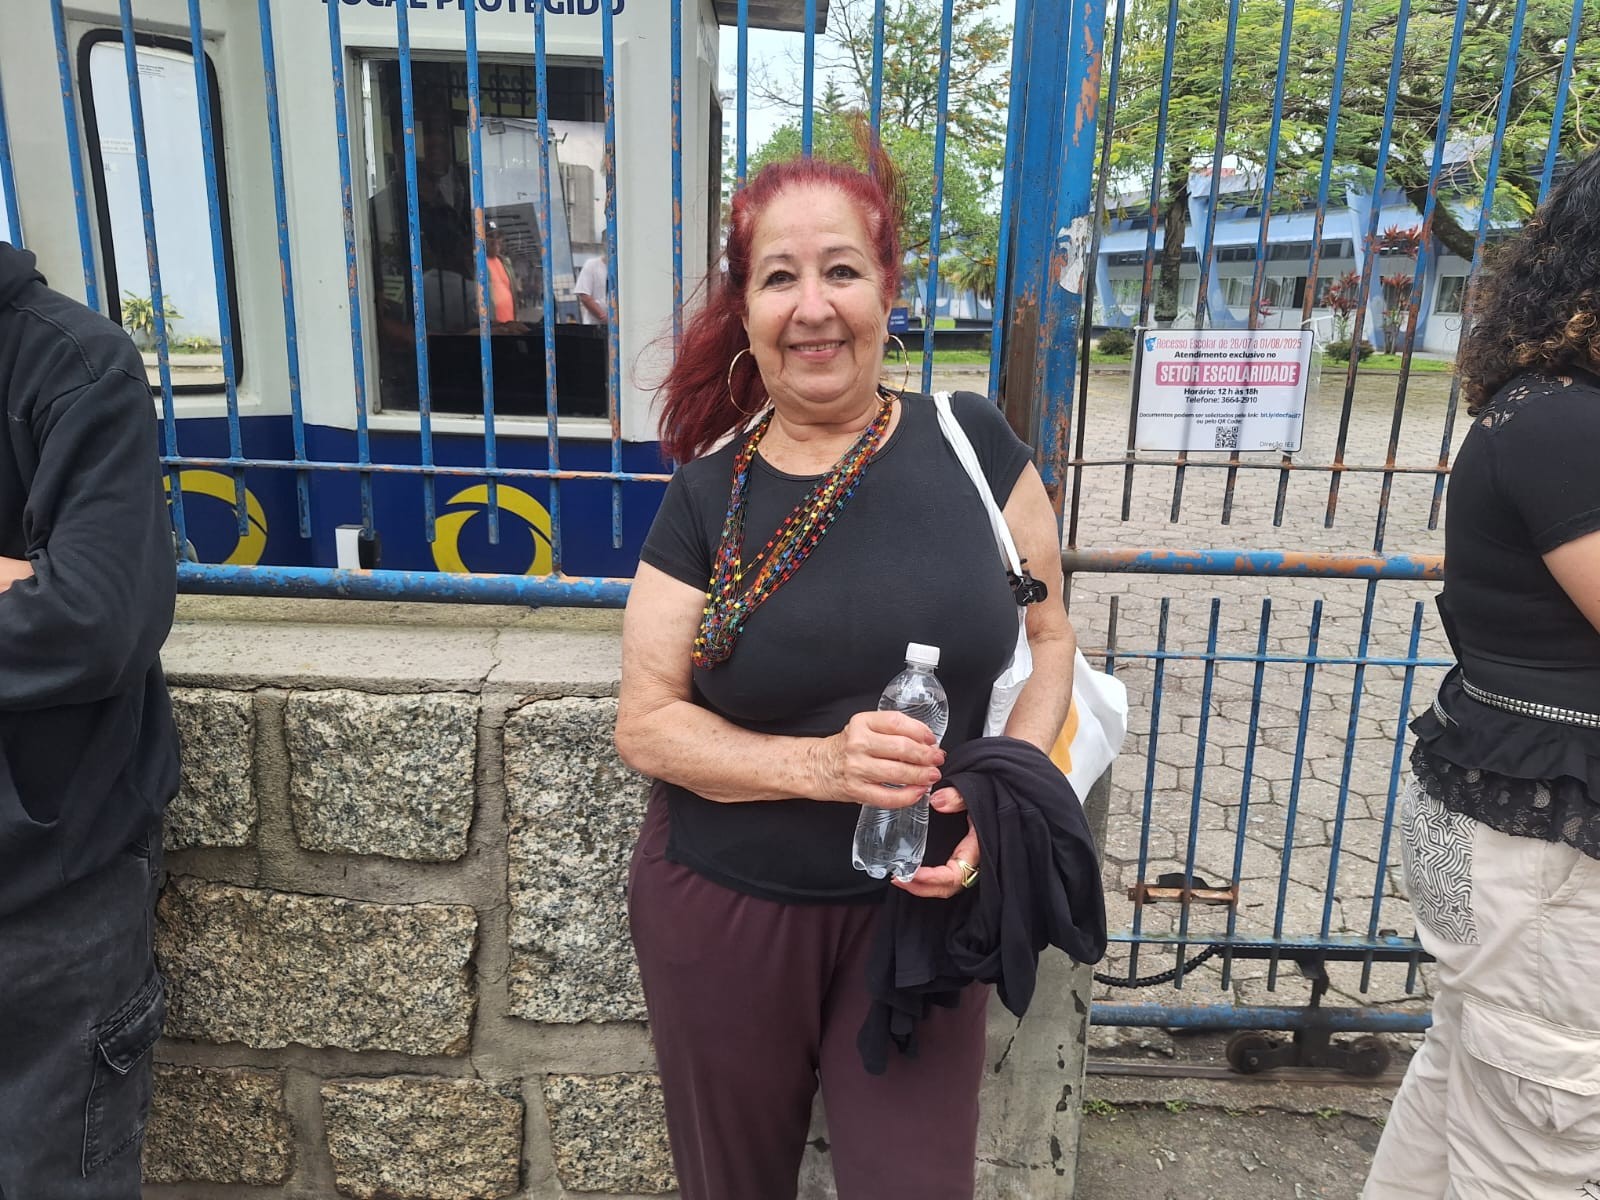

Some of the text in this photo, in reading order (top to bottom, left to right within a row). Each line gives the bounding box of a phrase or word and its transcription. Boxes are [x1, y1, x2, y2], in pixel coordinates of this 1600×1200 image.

[1156, 338, 1187, 349] Recesso
[1190, 338, 1216, 349] Escolar
[1219, 338, 1228, 349] de
[1230, 338, 1252, 349] 28/07
[1259, 338, 1302, 349] 01/08/2025
[1160, 365, 1296, 382] SETOR ESCOLARIDADE
[1184, 387, 1216, 395] Horário:
[1185, 396, 1219, 404] Telefone:
